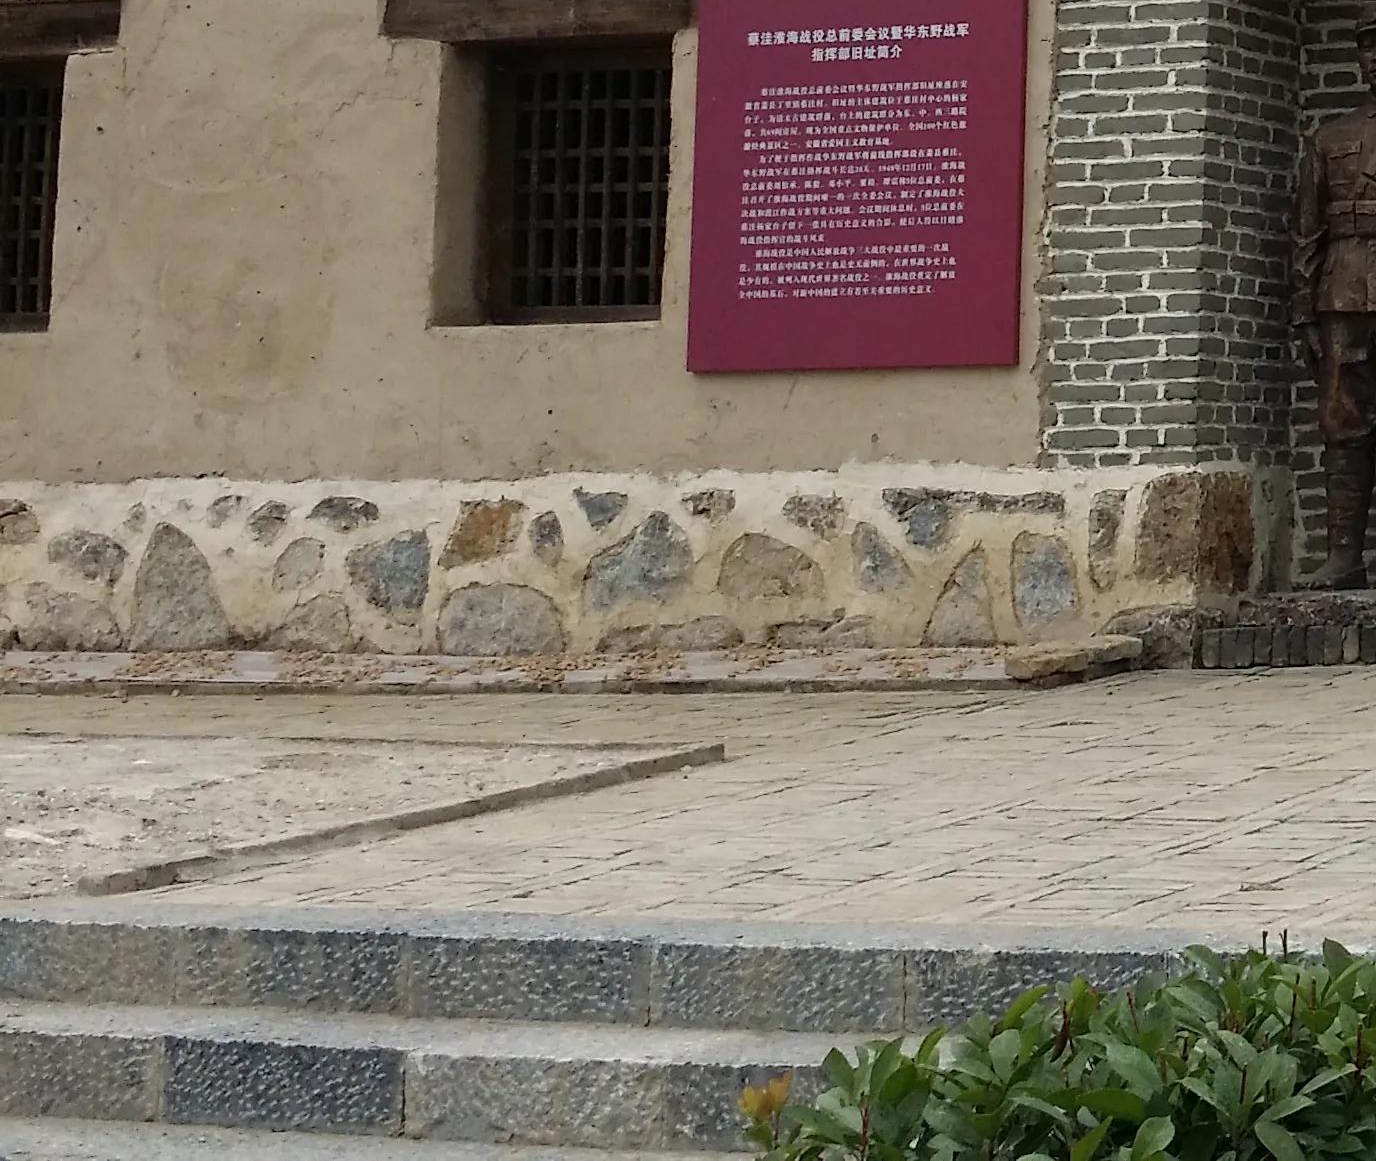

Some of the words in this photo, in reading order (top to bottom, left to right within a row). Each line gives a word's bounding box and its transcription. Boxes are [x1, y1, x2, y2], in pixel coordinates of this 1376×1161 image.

[746, 22, 969, 46] 蔡洼淮海战役总前委会议暨华东野战军
[811, 44, 902, 62] 指挥部旧址简介
